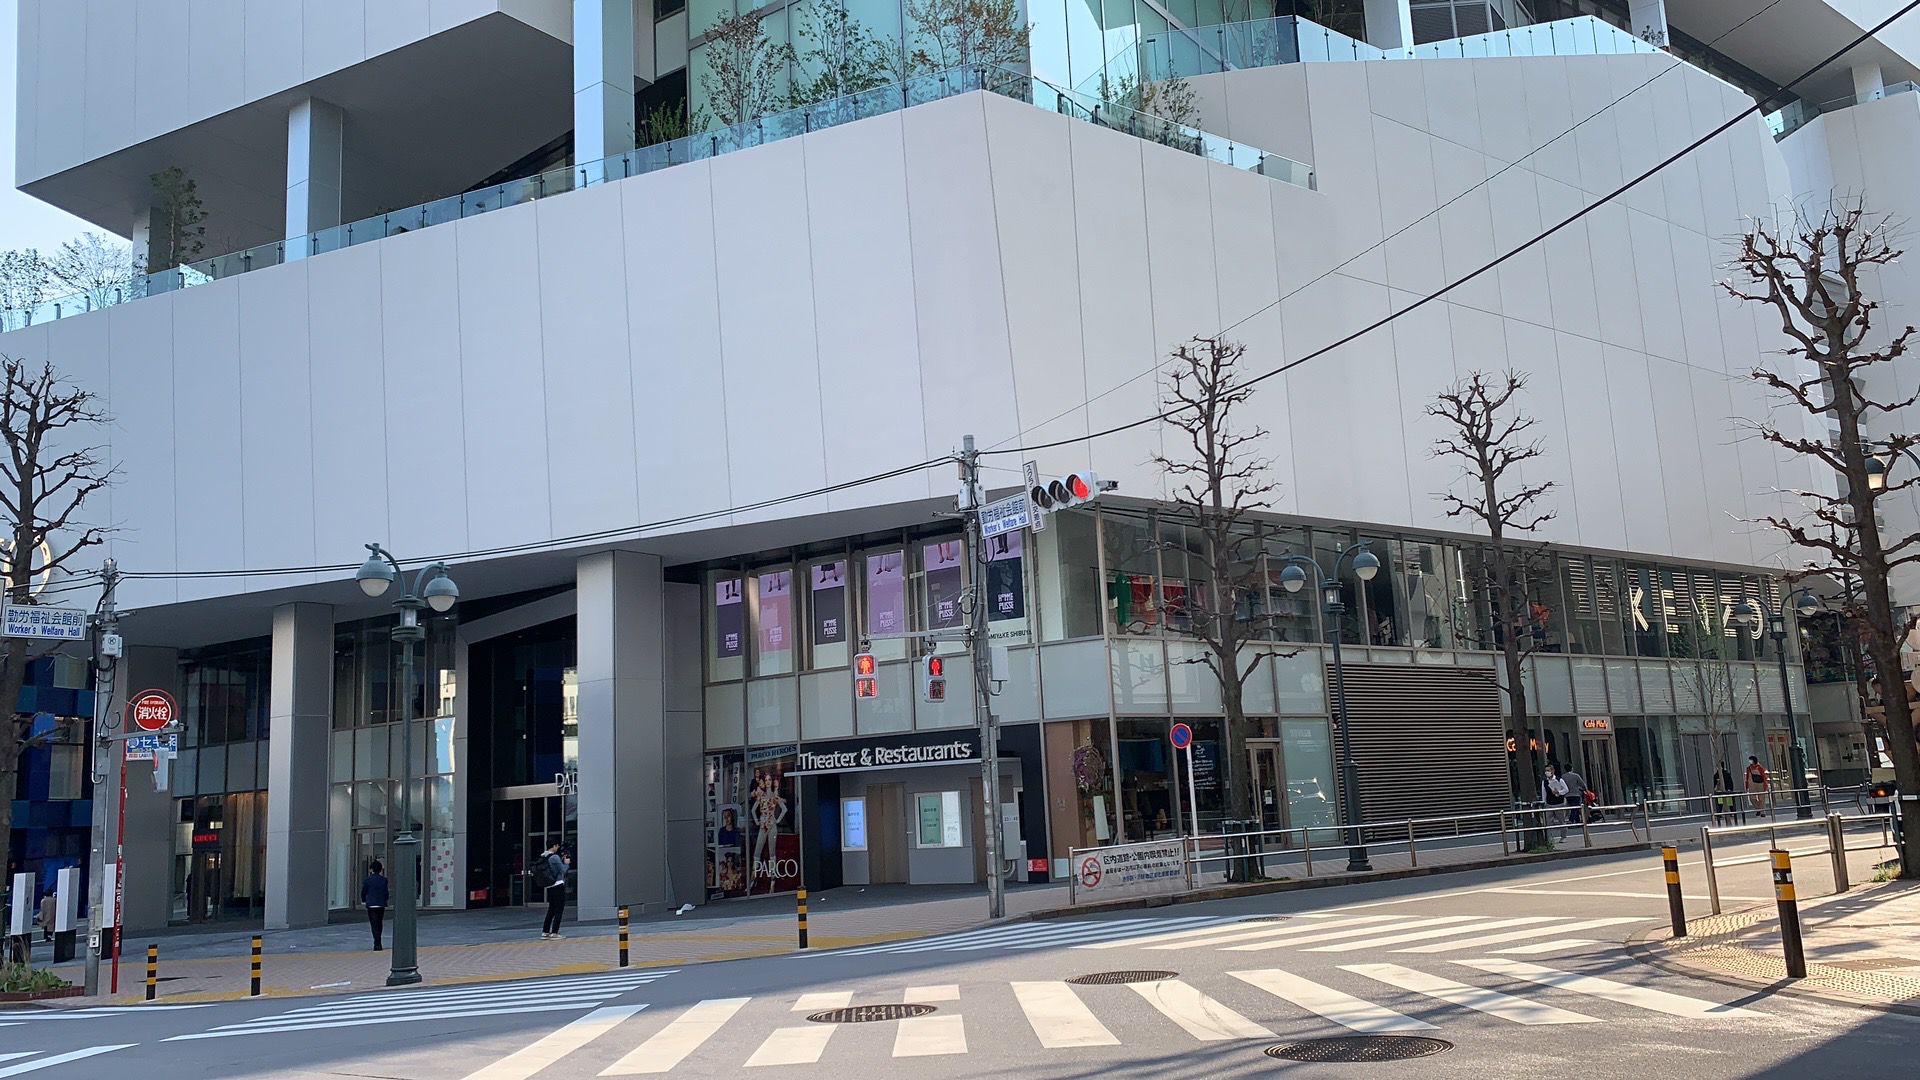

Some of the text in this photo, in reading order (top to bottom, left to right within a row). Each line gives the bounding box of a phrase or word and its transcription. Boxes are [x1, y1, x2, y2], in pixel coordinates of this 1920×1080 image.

[981, 498, 1026, 524] 勤労福祉会館前
[8, 609, 83, 627] 勤労福祉会館前
[8, 624, 80, 637] Worker's Welfare Hall
[138, 706, 168, 720] 消火栓
[800, 741, 972, 770] Theater & Restaurants
[753, 858, 799, 878] PARCO
